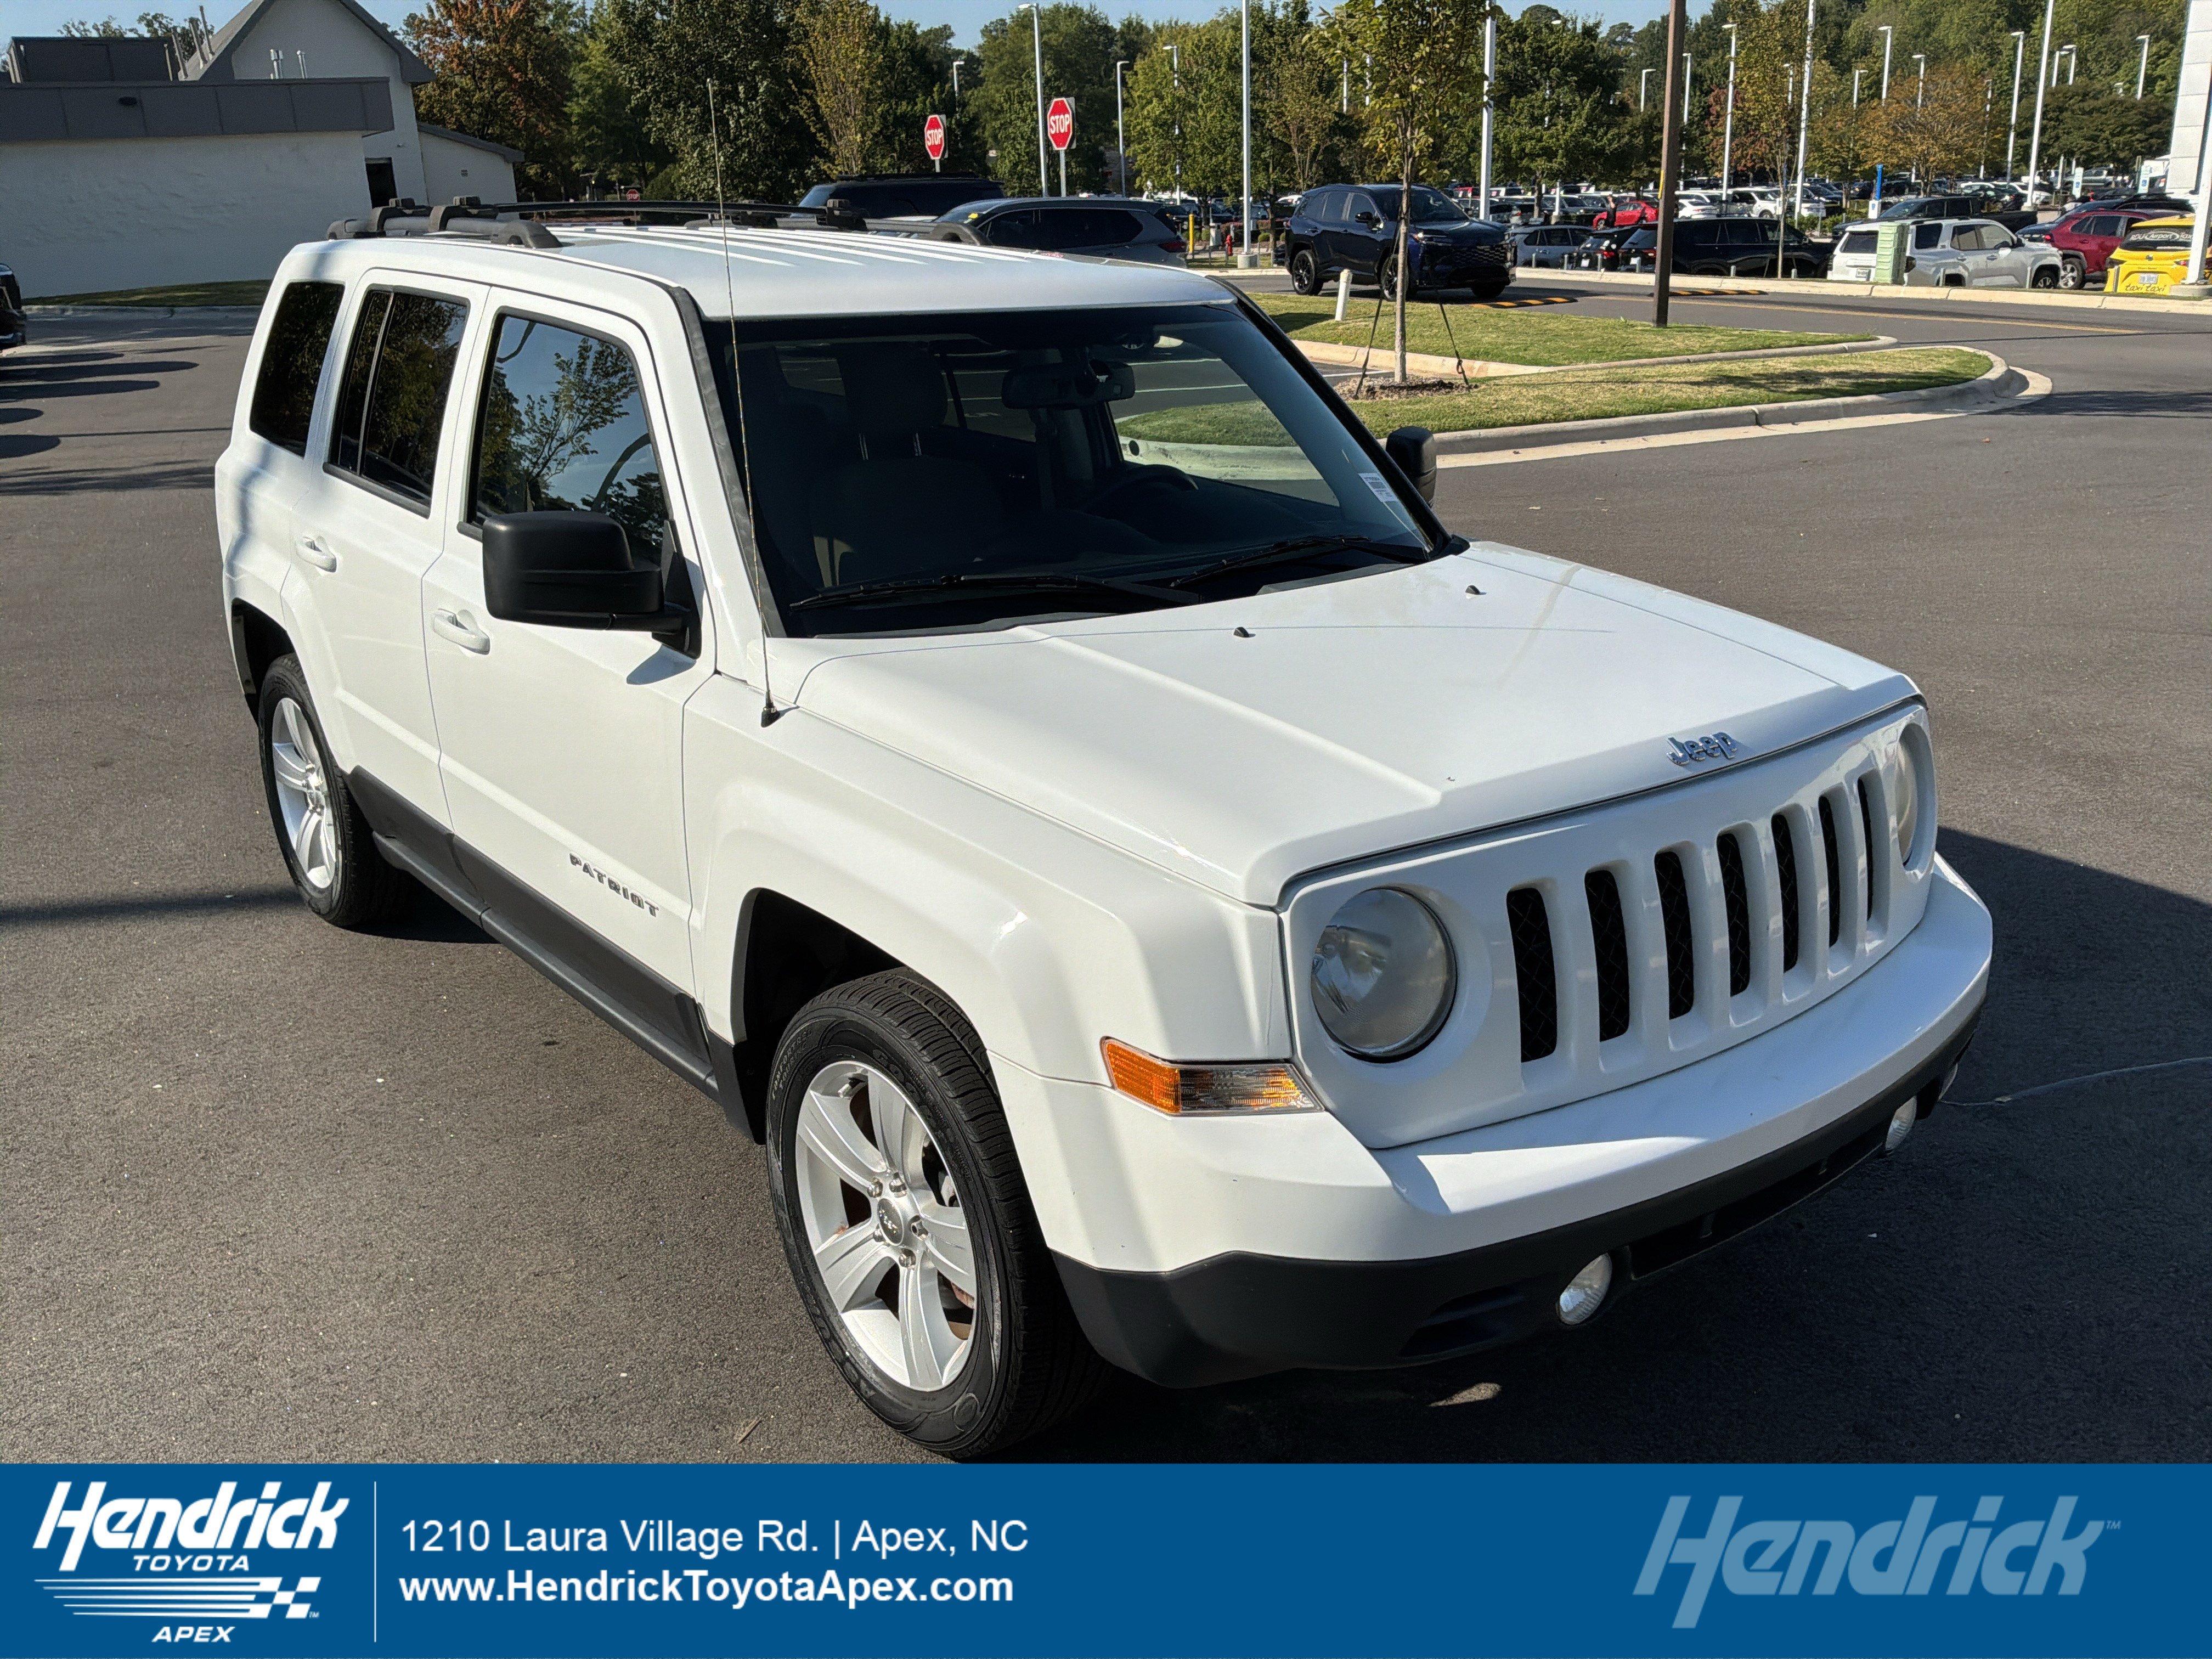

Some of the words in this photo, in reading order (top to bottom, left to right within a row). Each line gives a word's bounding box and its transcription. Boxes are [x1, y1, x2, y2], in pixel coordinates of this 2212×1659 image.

[1050, 114, 1070, 134] STOP
[927, 128, 942, 146] STOP
[2146, 284, 2166, 292] taxi
[1666, 732, 1737, 766] Jeep
[569, 853, 659, 917] PATRIOT
